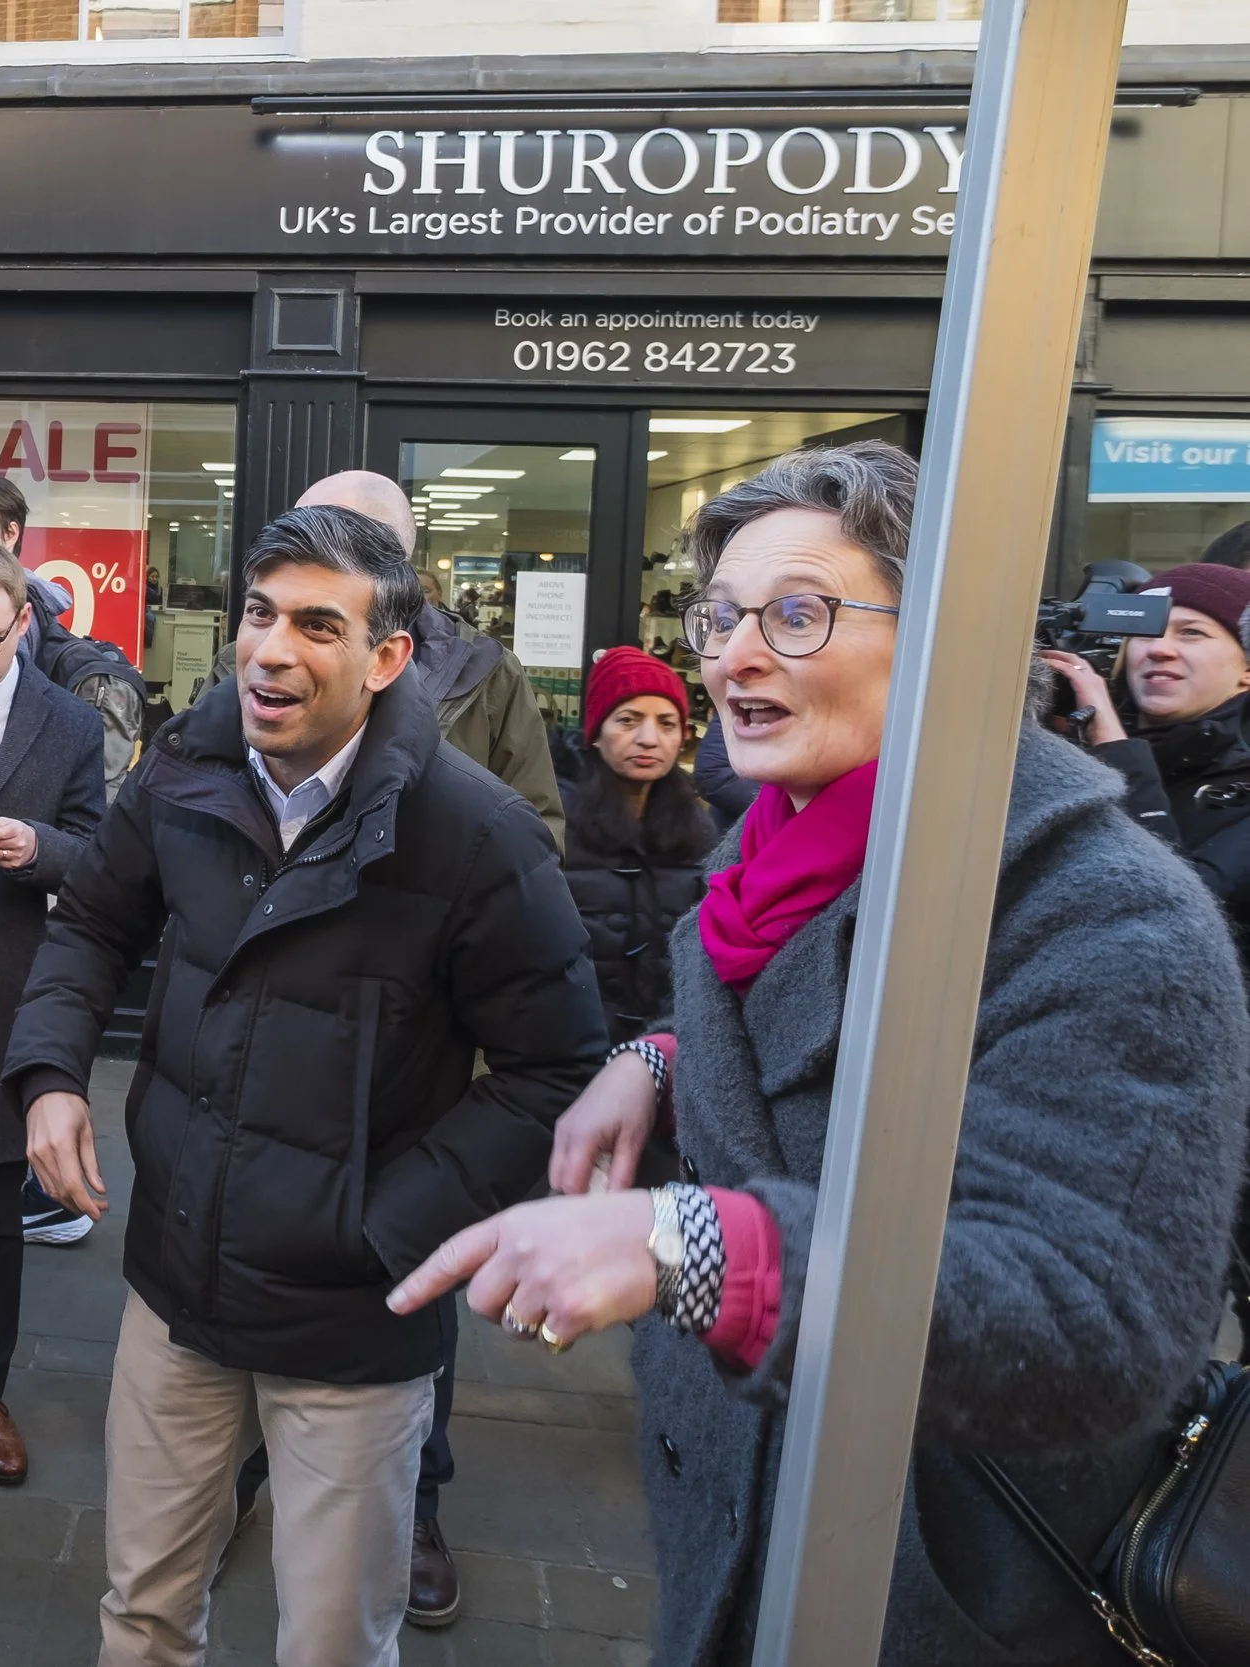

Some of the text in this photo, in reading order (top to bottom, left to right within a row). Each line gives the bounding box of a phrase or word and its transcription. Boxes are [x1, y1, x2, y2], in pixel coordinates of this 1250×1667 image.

[363, 126, 966, 195] SHUROPODY
[368, 206, 504, 241] Largest
[515, 206, 673, 237] Provider
[683, 205, 726, 236] of
[734, 205, 901, 241] Podiatry
[494, 309, 819, 333] Book an appointment today
[513, 340, 797, 374] 01962 842723
[1103, 440, 1174, 464] Visit
[1181, 446, 1238, 465] our
